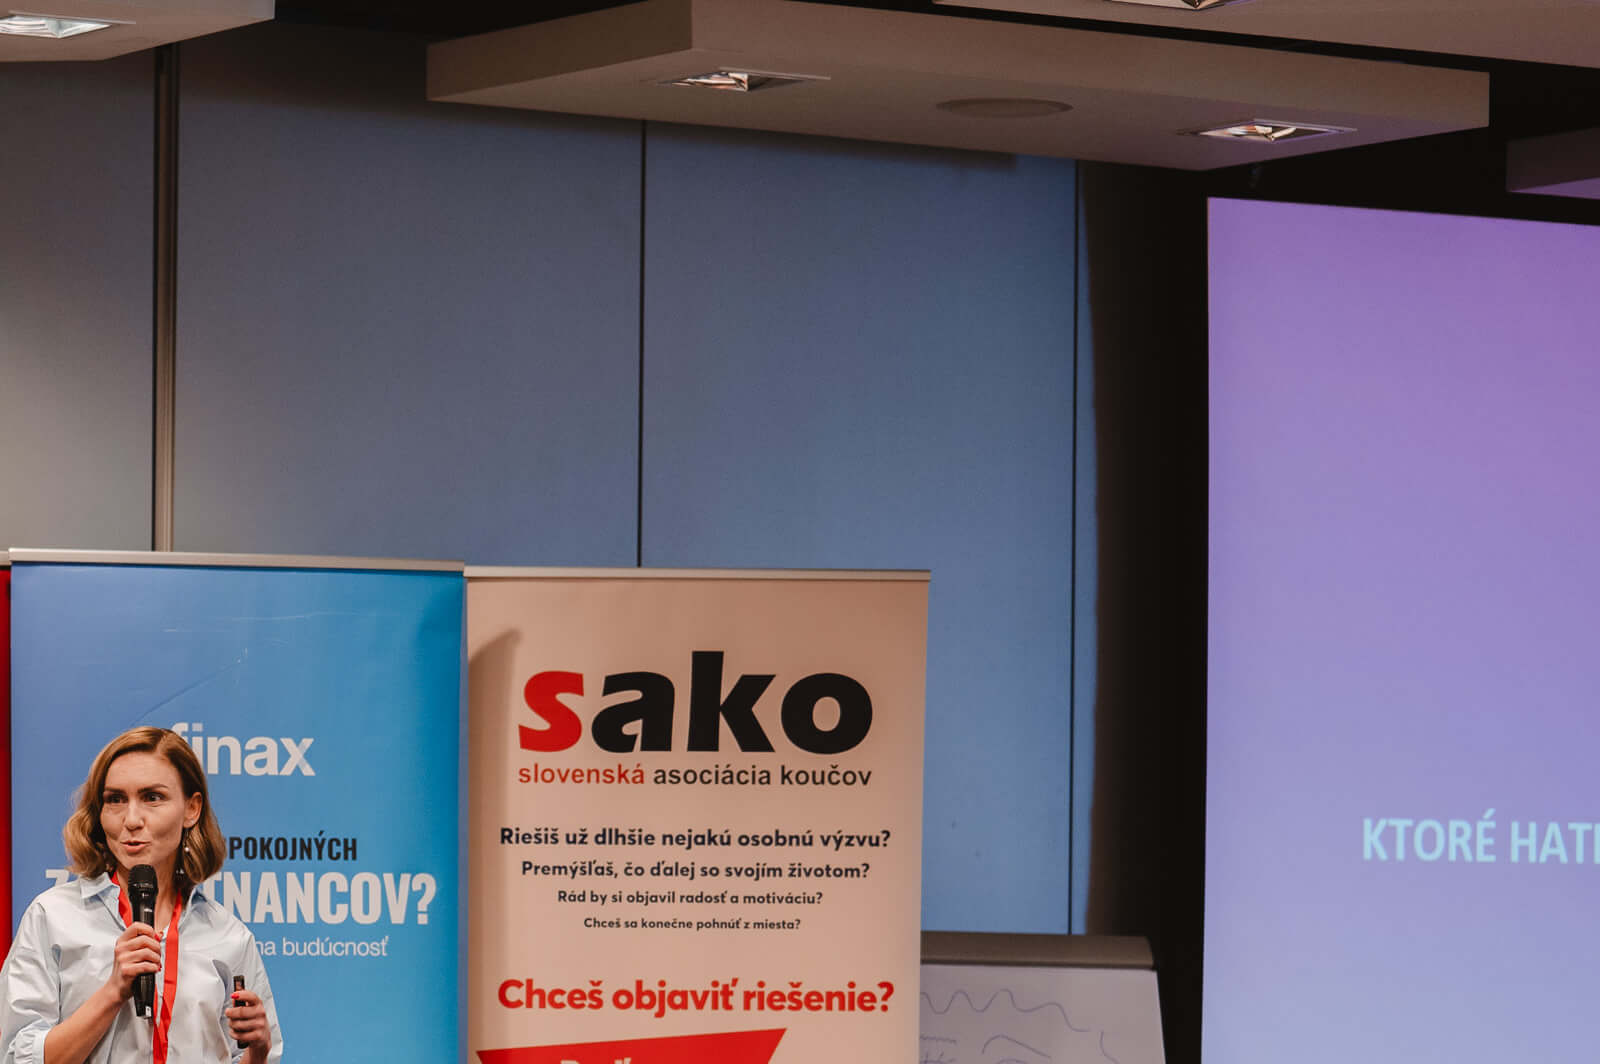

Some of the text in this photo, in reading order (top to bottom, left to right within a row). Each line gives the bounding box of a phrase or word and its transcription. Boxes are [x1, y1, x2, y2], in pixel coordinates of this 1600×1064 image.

[518, 650, 874, 756] sako
[518, 763, 873, 786] slovenská asociácia koučov
[224, 830, 358, 861] POKOJNÝCH
[500, 827, 891, 852] Riešiš už dlhšie nejakú osobnú výzvu?
[1363, 808, 1497, 863] KTORÉ
[521, 859, 871, 882] Premýšľaš, čo ďalej so svojím životom?
[557, 889, 823, 907] Rád by si objavil radosť a motiváciu?
[583, 916, 801, 932] Chceš sa konečne pohnúť z miesta?
[282, 936, 390, 958] budúcnosť
[497, 977, 896, 1019] Chceš objaviť riešenie?
